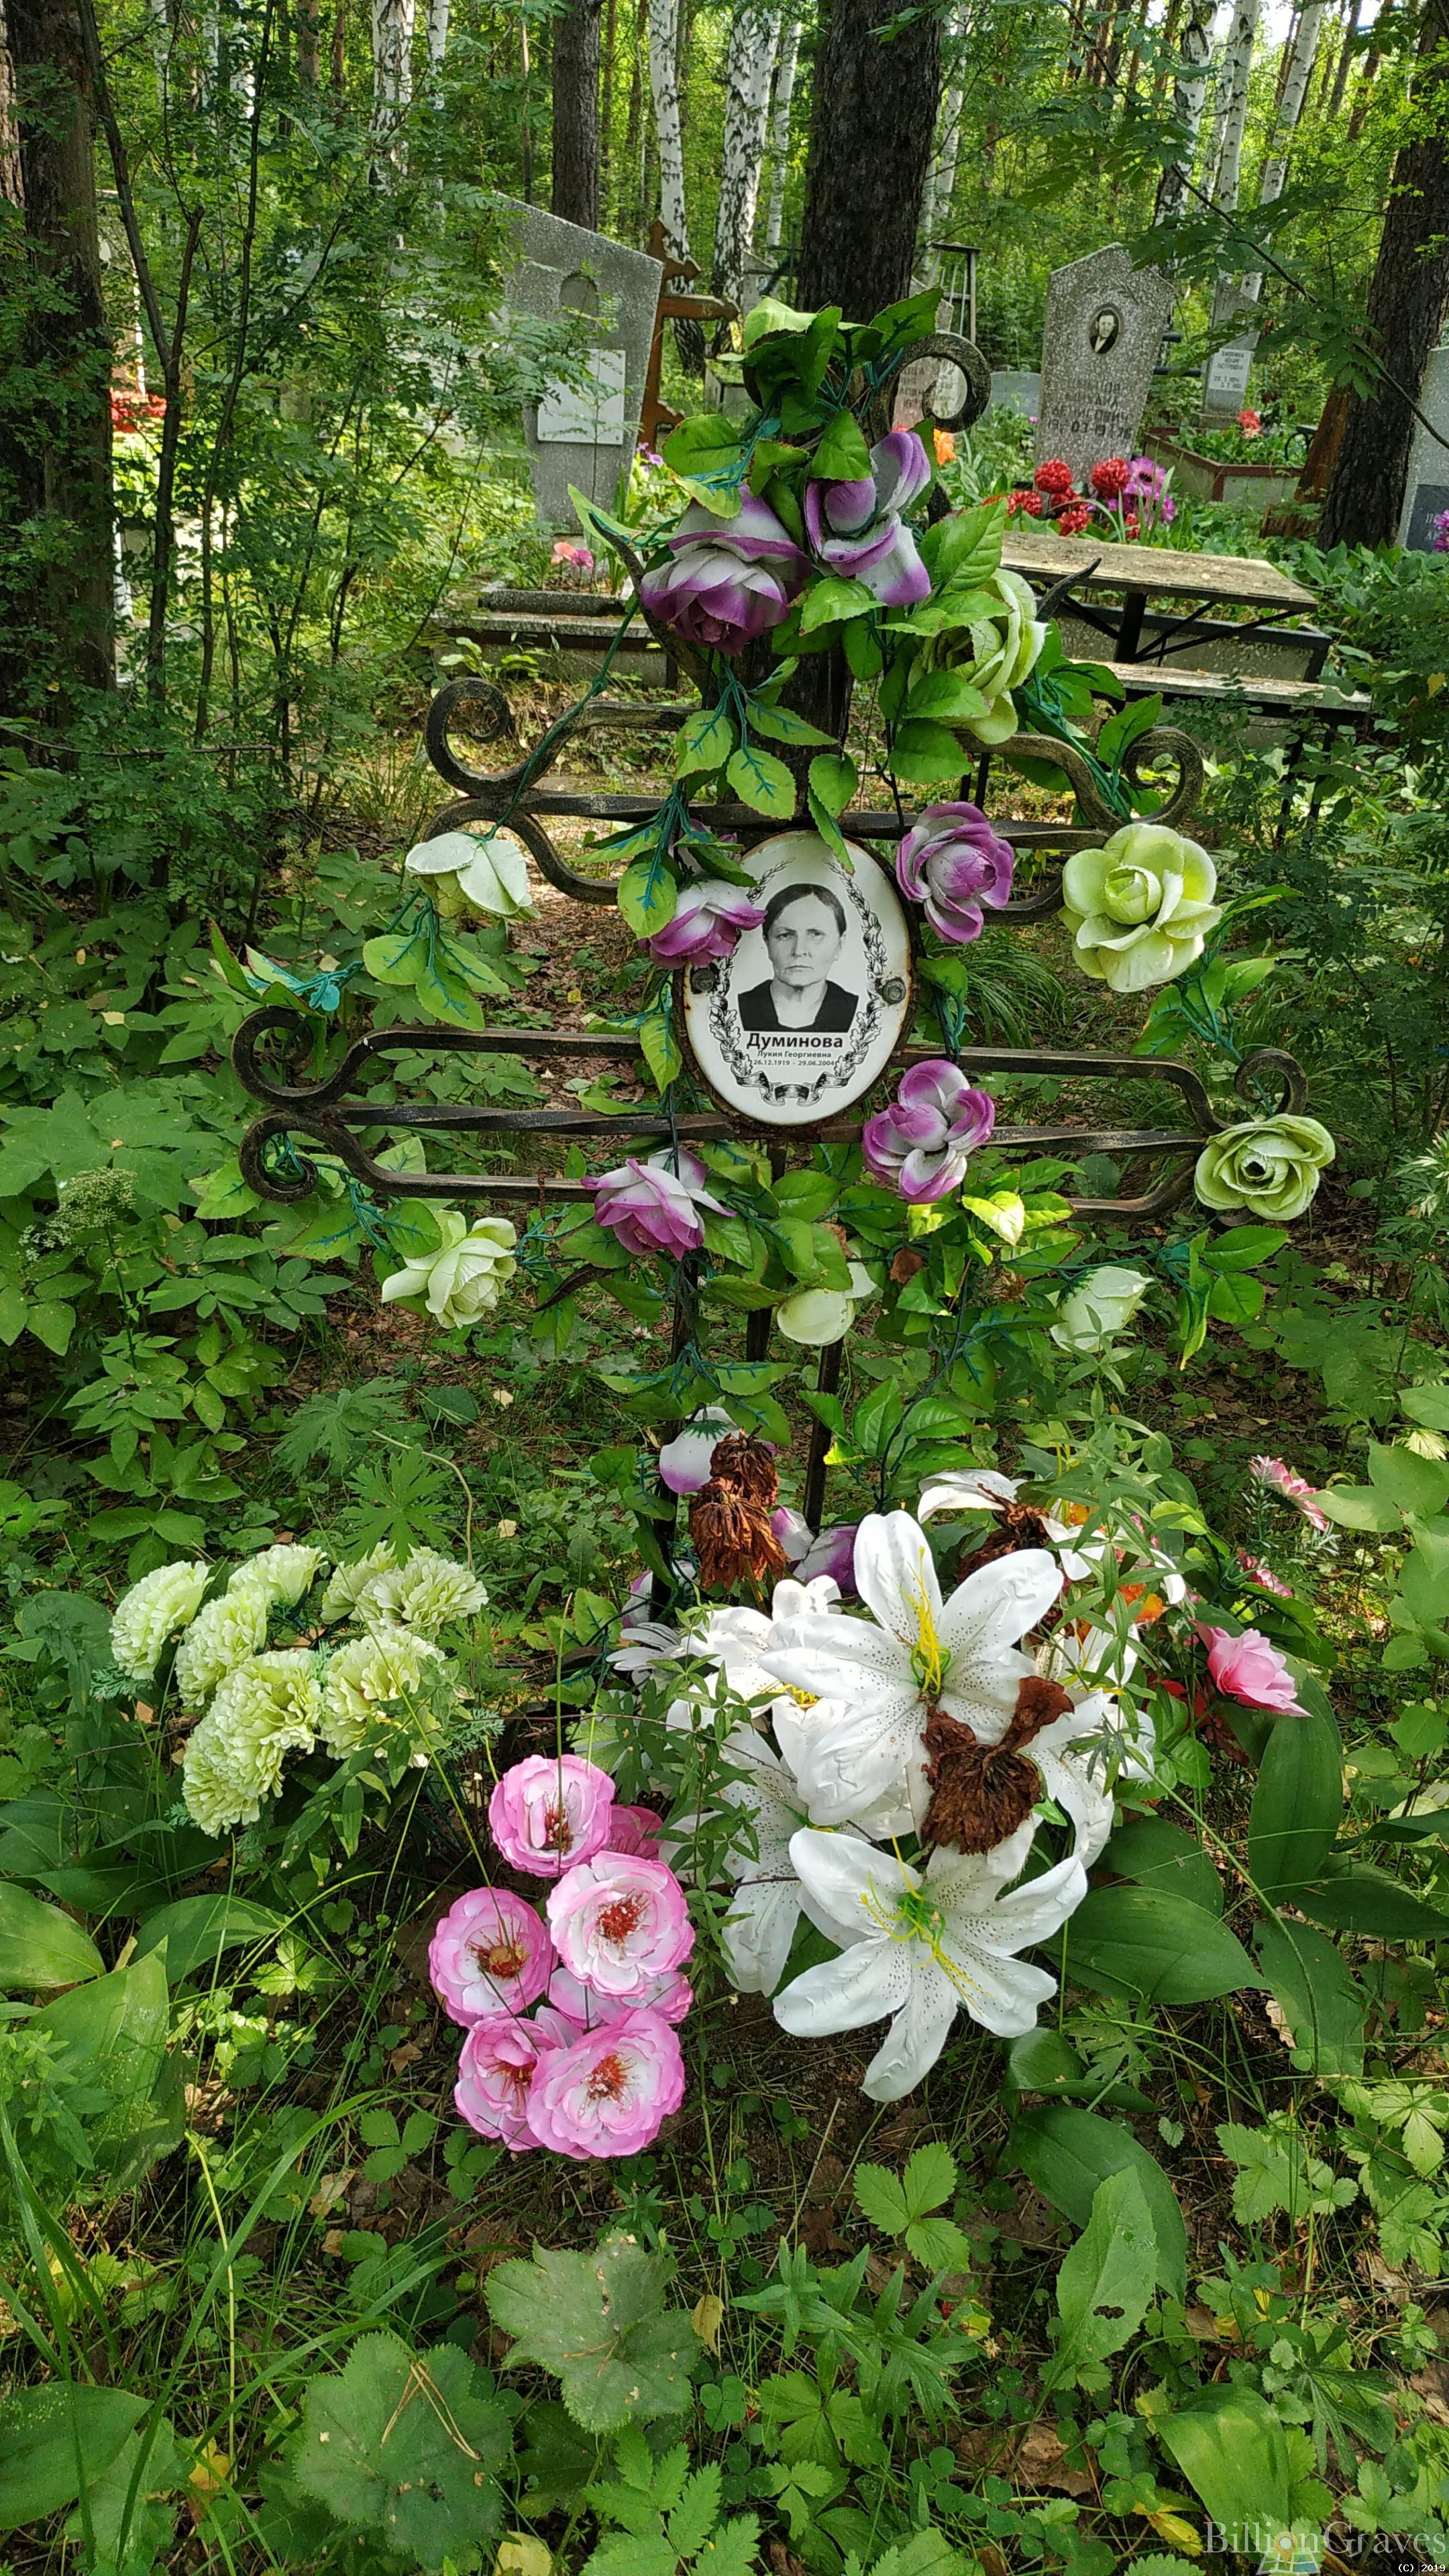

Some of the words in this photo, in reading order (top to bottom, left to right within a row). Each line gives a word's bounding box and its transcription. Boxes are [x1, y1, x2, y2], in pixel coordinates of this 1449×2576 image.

[746, 1032, 843, 1051] Думинова
[757, 1051, 783, 1059] Лукия
[784, 1051, 832, 1059] Георгиевна
